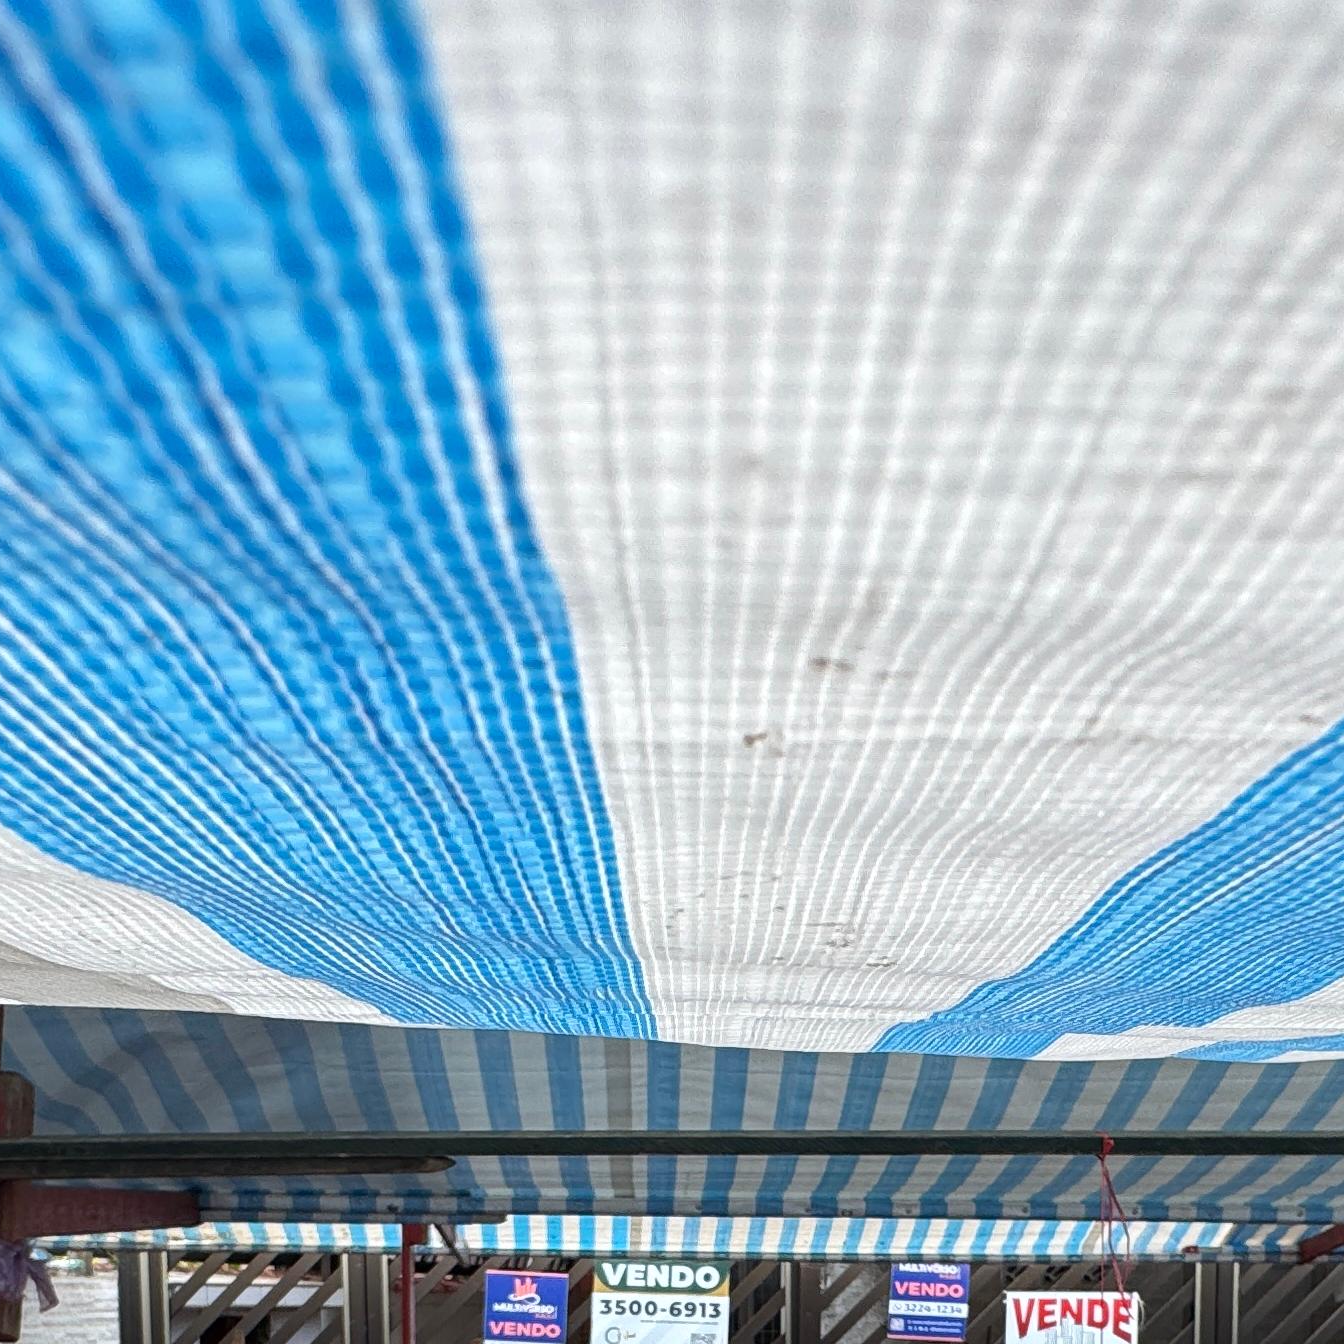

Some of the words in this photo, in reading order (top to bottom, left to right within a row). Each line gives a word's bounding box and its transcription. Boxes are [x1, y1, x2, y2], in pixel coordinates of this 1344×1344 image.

[602, 1262, 720, 1290] VENDO
[894, 1281, 964, 1298] VENDO
[598, 1300, 723, 1319] 3500-6913
[1013, 1297, 1132, 1344] VENDE
[489, 1321, 561, 1340] VENDO
